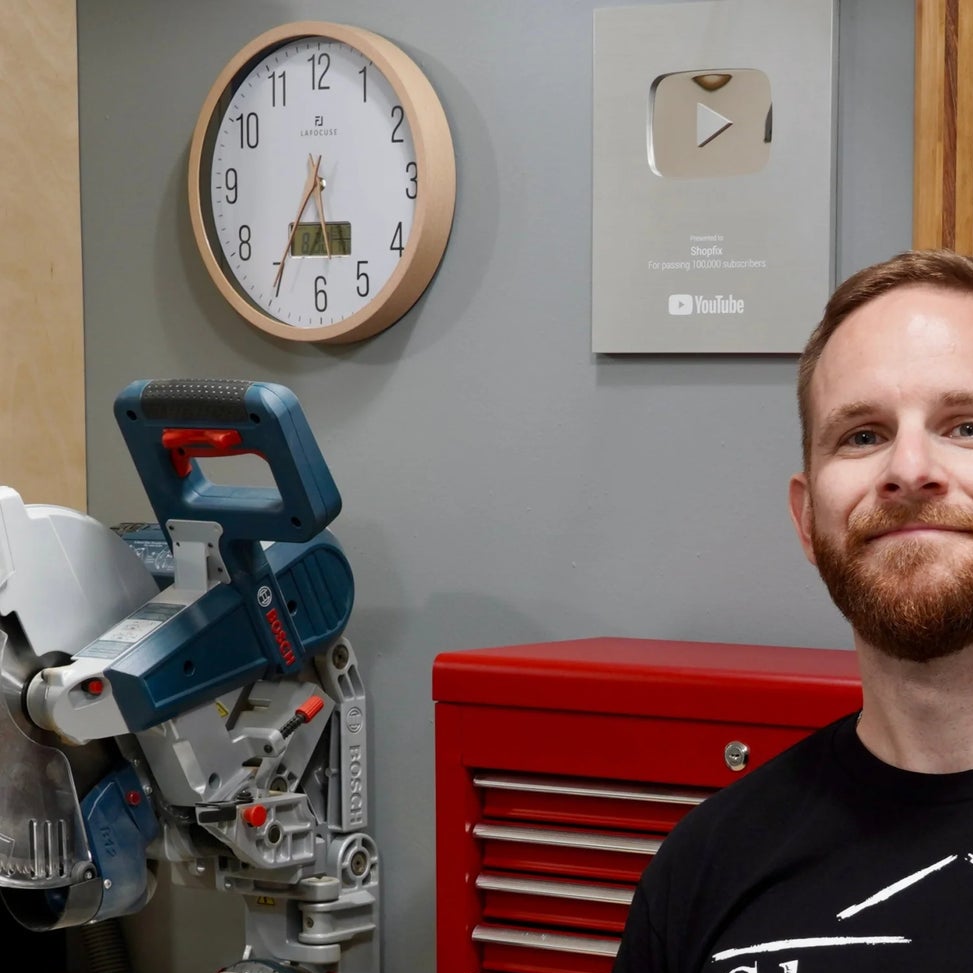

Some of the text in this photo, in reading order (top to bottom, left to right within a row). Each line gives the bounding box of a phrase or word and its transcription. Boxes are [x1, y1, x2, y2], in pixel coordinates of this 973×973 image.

[267, 70, 287, 107] 11
[307, 52, 331, 91] 12
[358, 65, 367, 103] 1
[235, 112, 260, 149] 10
[300, 128, 338, 137] LAFOCUSE
[391, 104, 405, 143] 2
[224, 167, 239, 204] 9
[405, 161, 418, 199] 3
[238, 224, 251, 261] 8
[389, 221, 405, 258] 4
[690, 244, 723, 257] Shopfix
[356, 260, 370, 298] 5
[648, 258, 767, 271] For passing 100,000 subscribers
[313, 275, 328, 313] 6
[694, 294, 744, 314] YouTube
[265, 607, 297, 667] BOSCH
[349, 744, 363, 825] BOSCH
